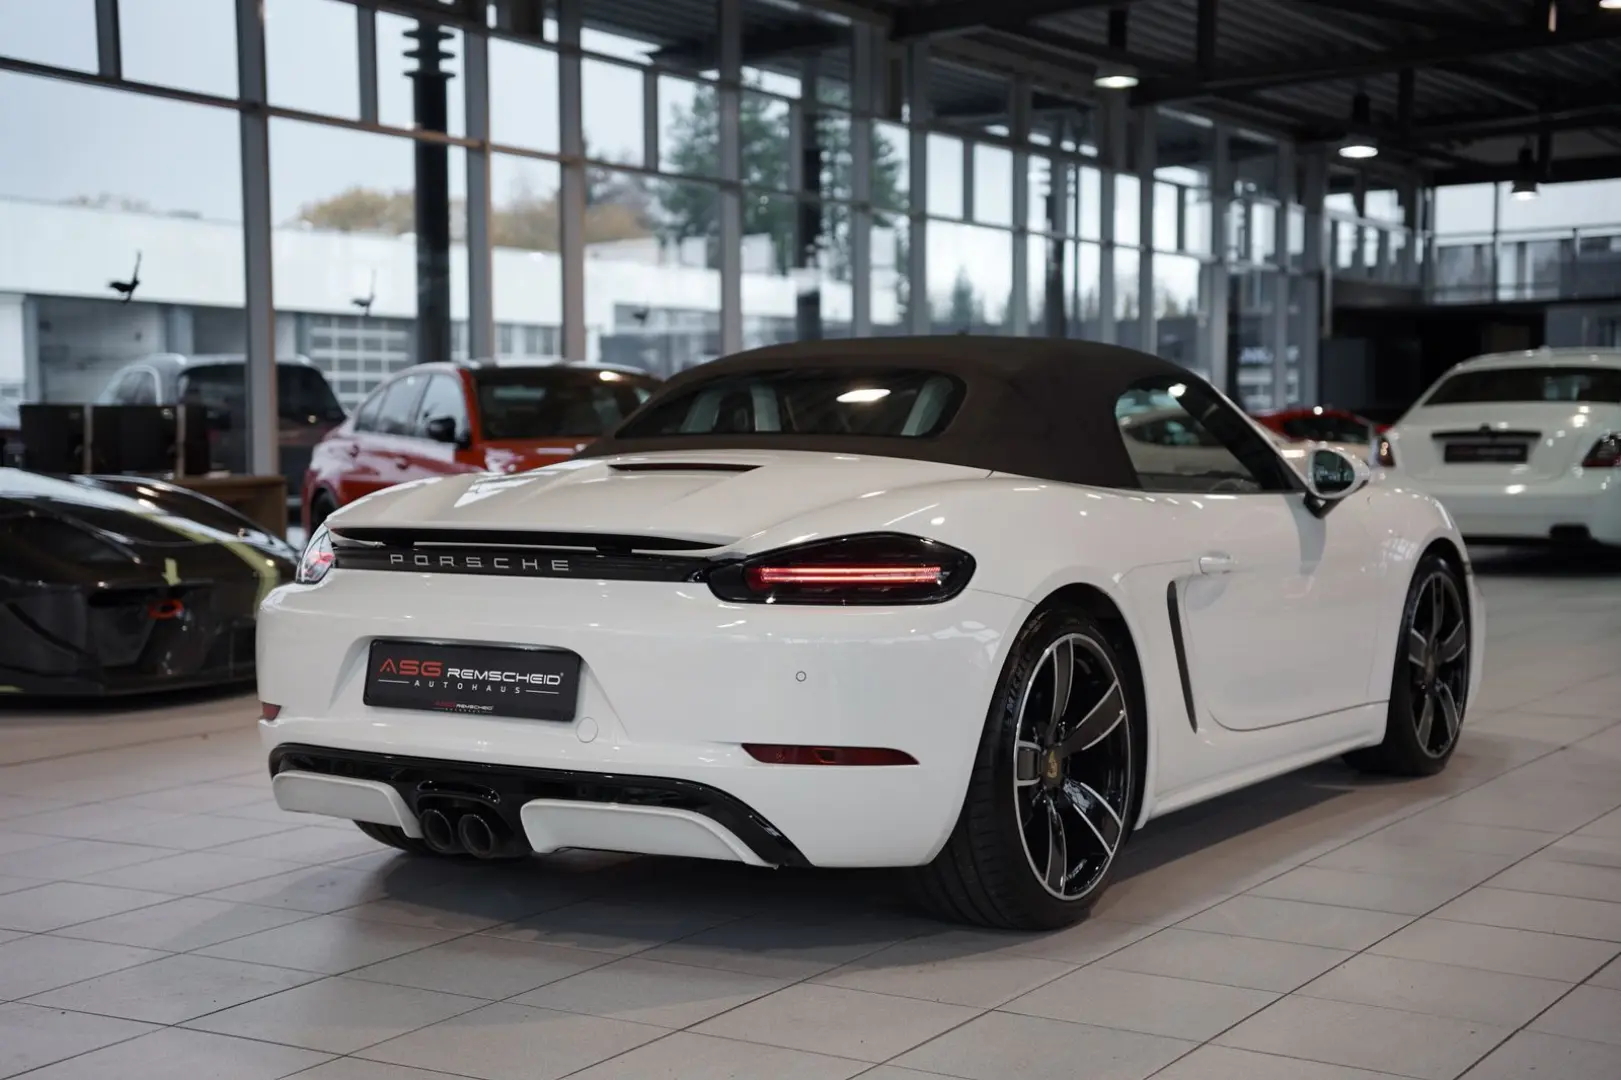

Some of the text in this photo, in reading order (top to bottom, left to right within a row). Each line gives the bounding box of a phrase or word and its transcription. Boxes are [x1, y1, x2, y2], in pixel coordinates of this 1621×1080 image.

[390, 553, 570, 571] PORSCHE
[380, 658, 562, 686] ASG REMSCHEID
[414, 680, 520, 694] AUTOHAUS
